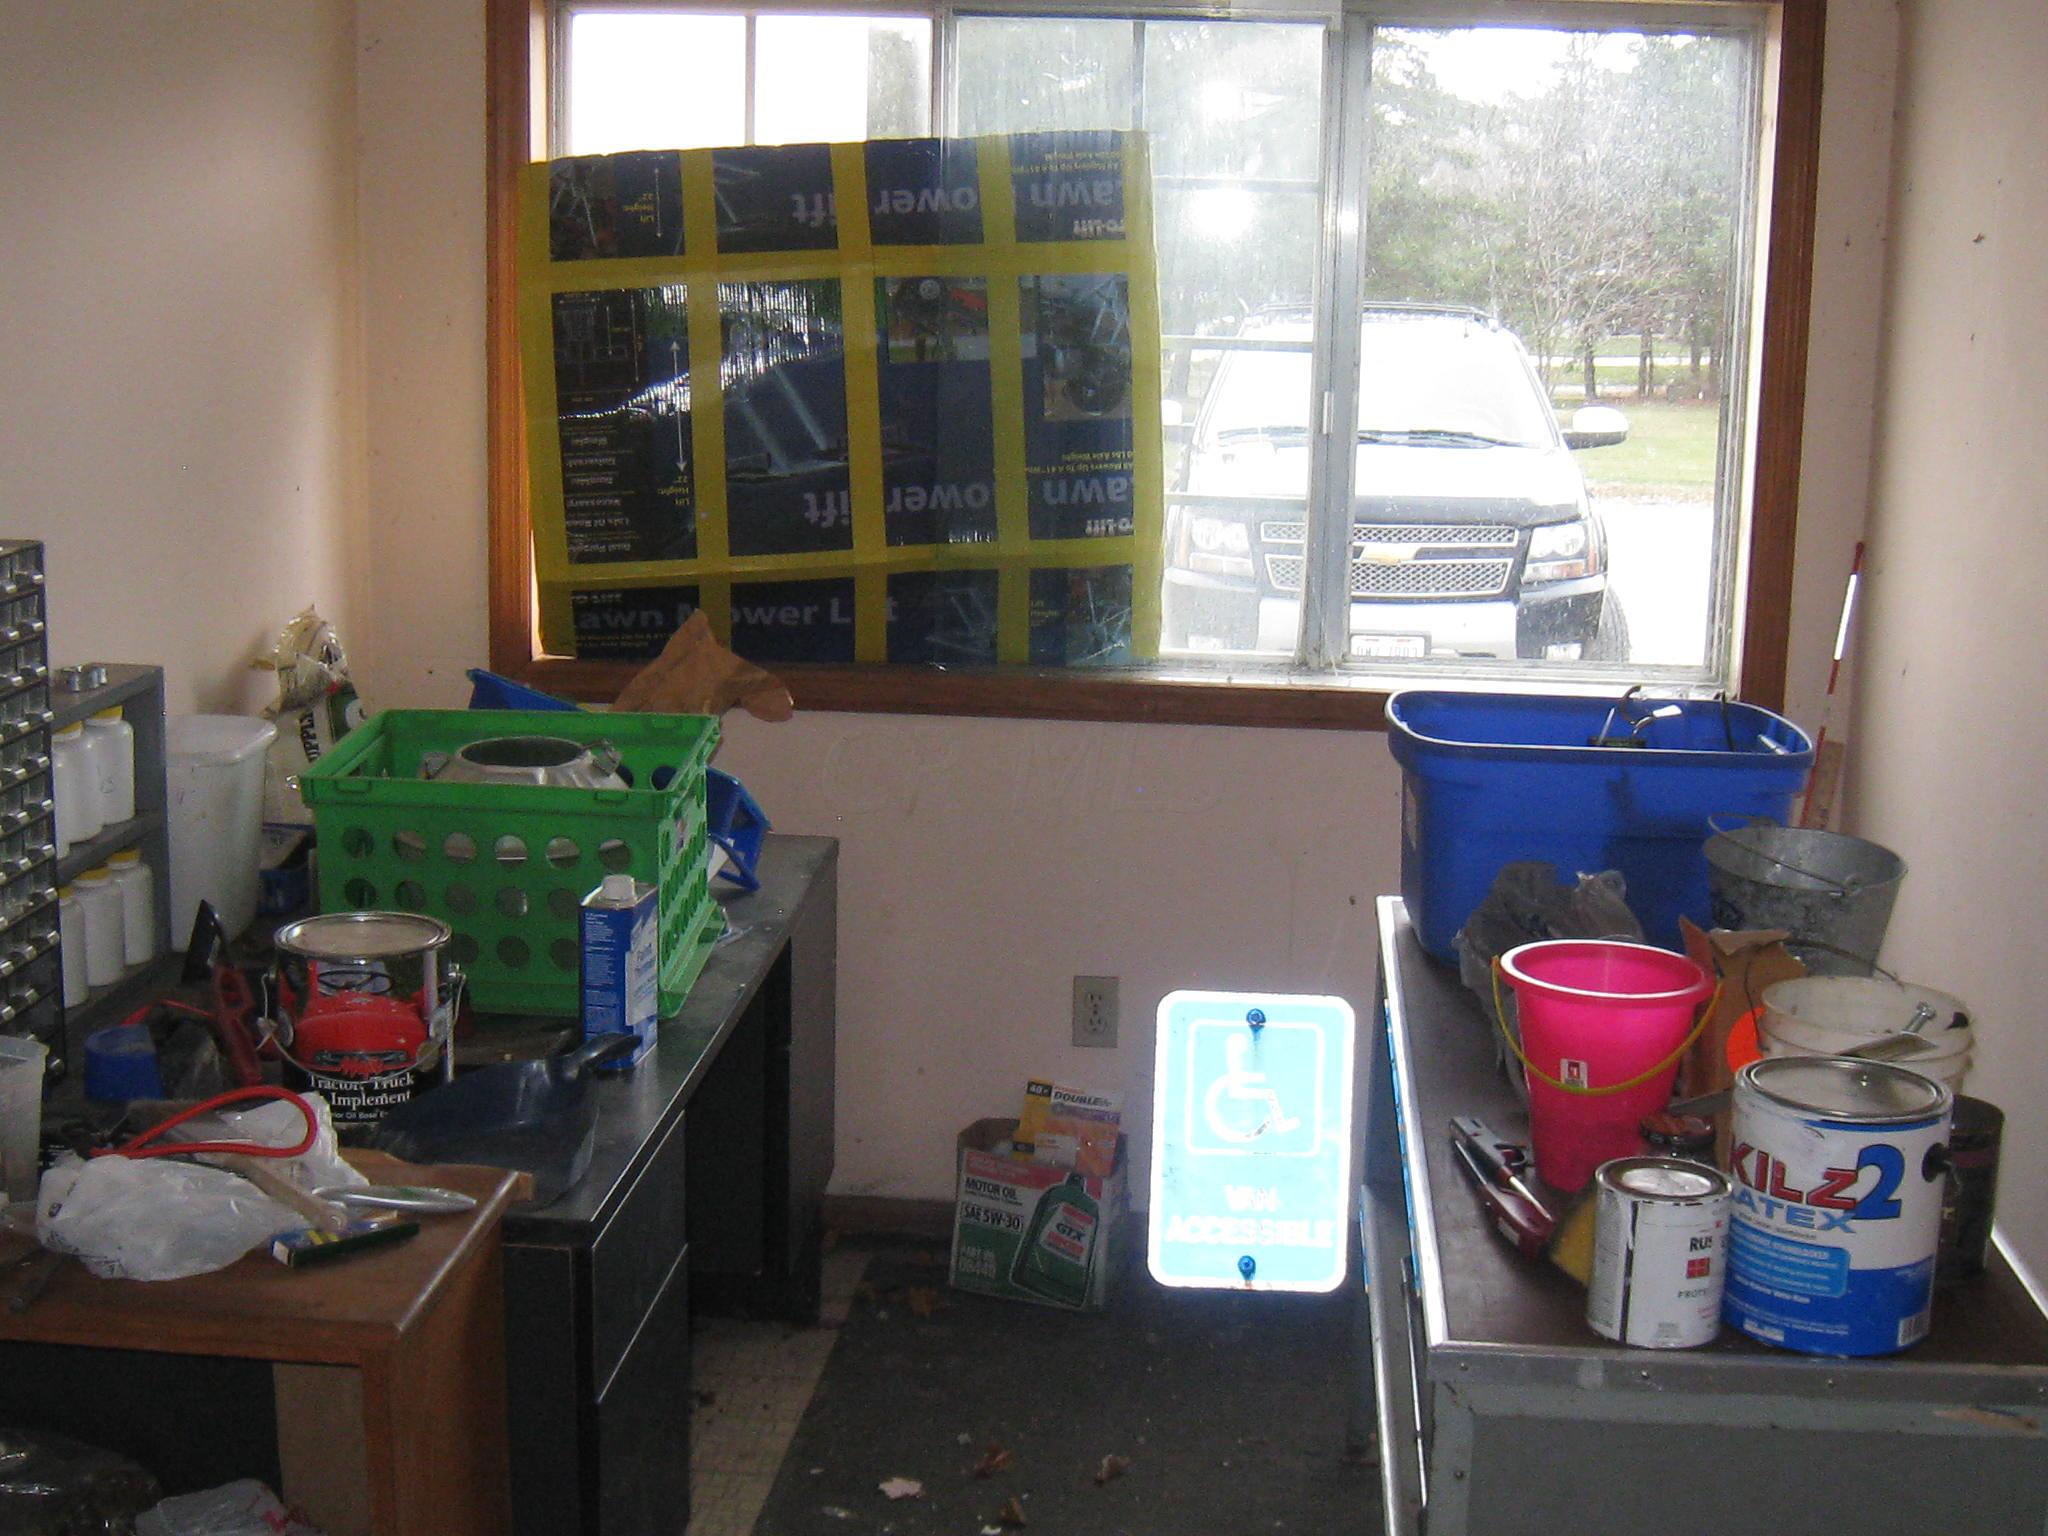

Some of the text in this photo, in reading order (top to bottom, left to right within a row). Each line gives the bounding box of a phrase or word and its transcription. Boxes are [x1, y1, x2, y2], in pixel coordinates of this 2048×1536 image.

[873, 187, 978, 215] ower
[1029, 180, 1114, 209] awn
[789, 193, 836, 228] ift
[886, 482, 990, 511] ower
[1042, 477, 1129, 506] awn
[803, 489, 850, 528] ift
[578, 609, 664, 629] awn
[299, 711, 320, 763] UPPLY
[370, 1071, 415, 1091] Truck
[331, 1090, 411, 1112] Implement
[964, 1177, 1000, 1197] MOTOR
[1002, 1185, 1017, 1200] OIL
[1731, 1143, 1905, 1220] KILZ 2
[1225, 1184, 1279, 1213] VAN
[1733, 1187, 1856, 1234] ATEX
[963, 1203, 1020, 1232] SAE 5W-30
[1056, 1222, 1086, 1242] GTX
[1164, 1214, 1334, 1248] ACCESSIBLE
